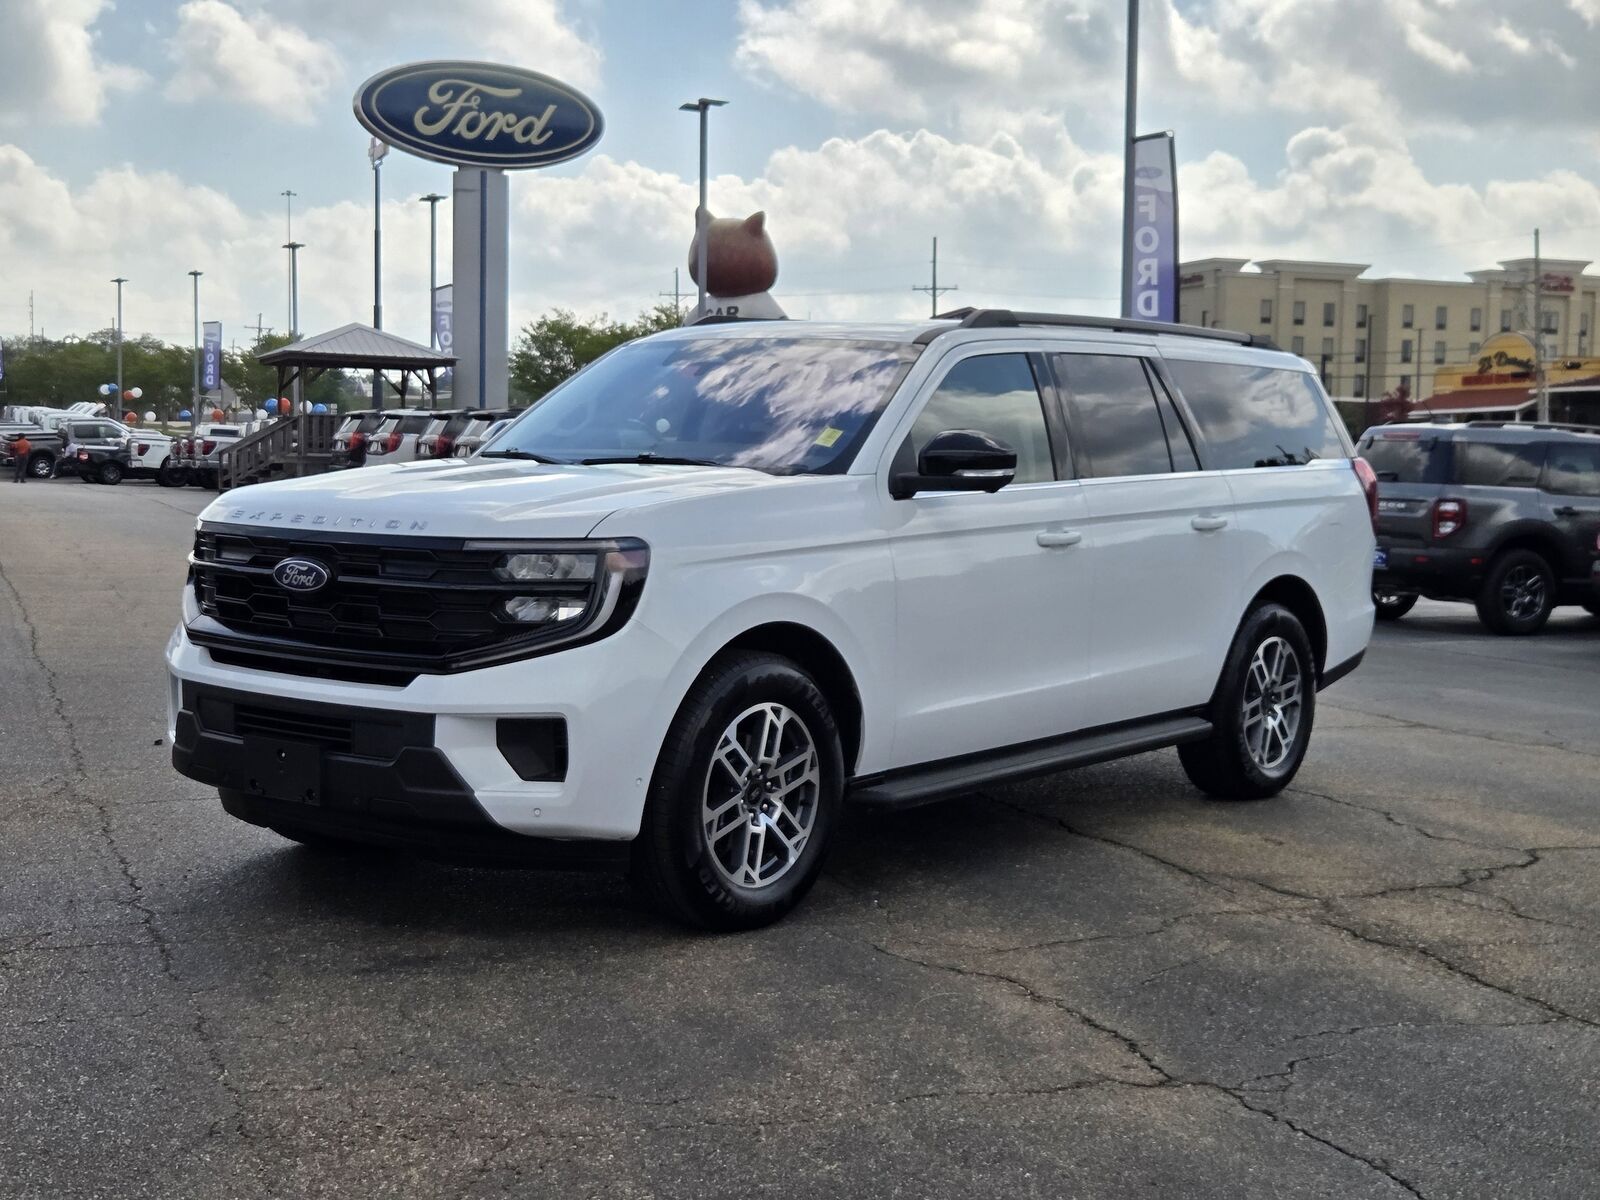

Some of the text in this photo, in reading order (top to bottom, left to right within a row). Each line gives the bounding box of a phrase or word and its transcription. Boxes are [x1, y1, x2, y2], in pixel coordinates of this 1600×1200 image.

[414, 79, 557, 145] Ford
[231, 509, 429, 531] EXPEDITION
[282, 564, 317, 588] Ford
